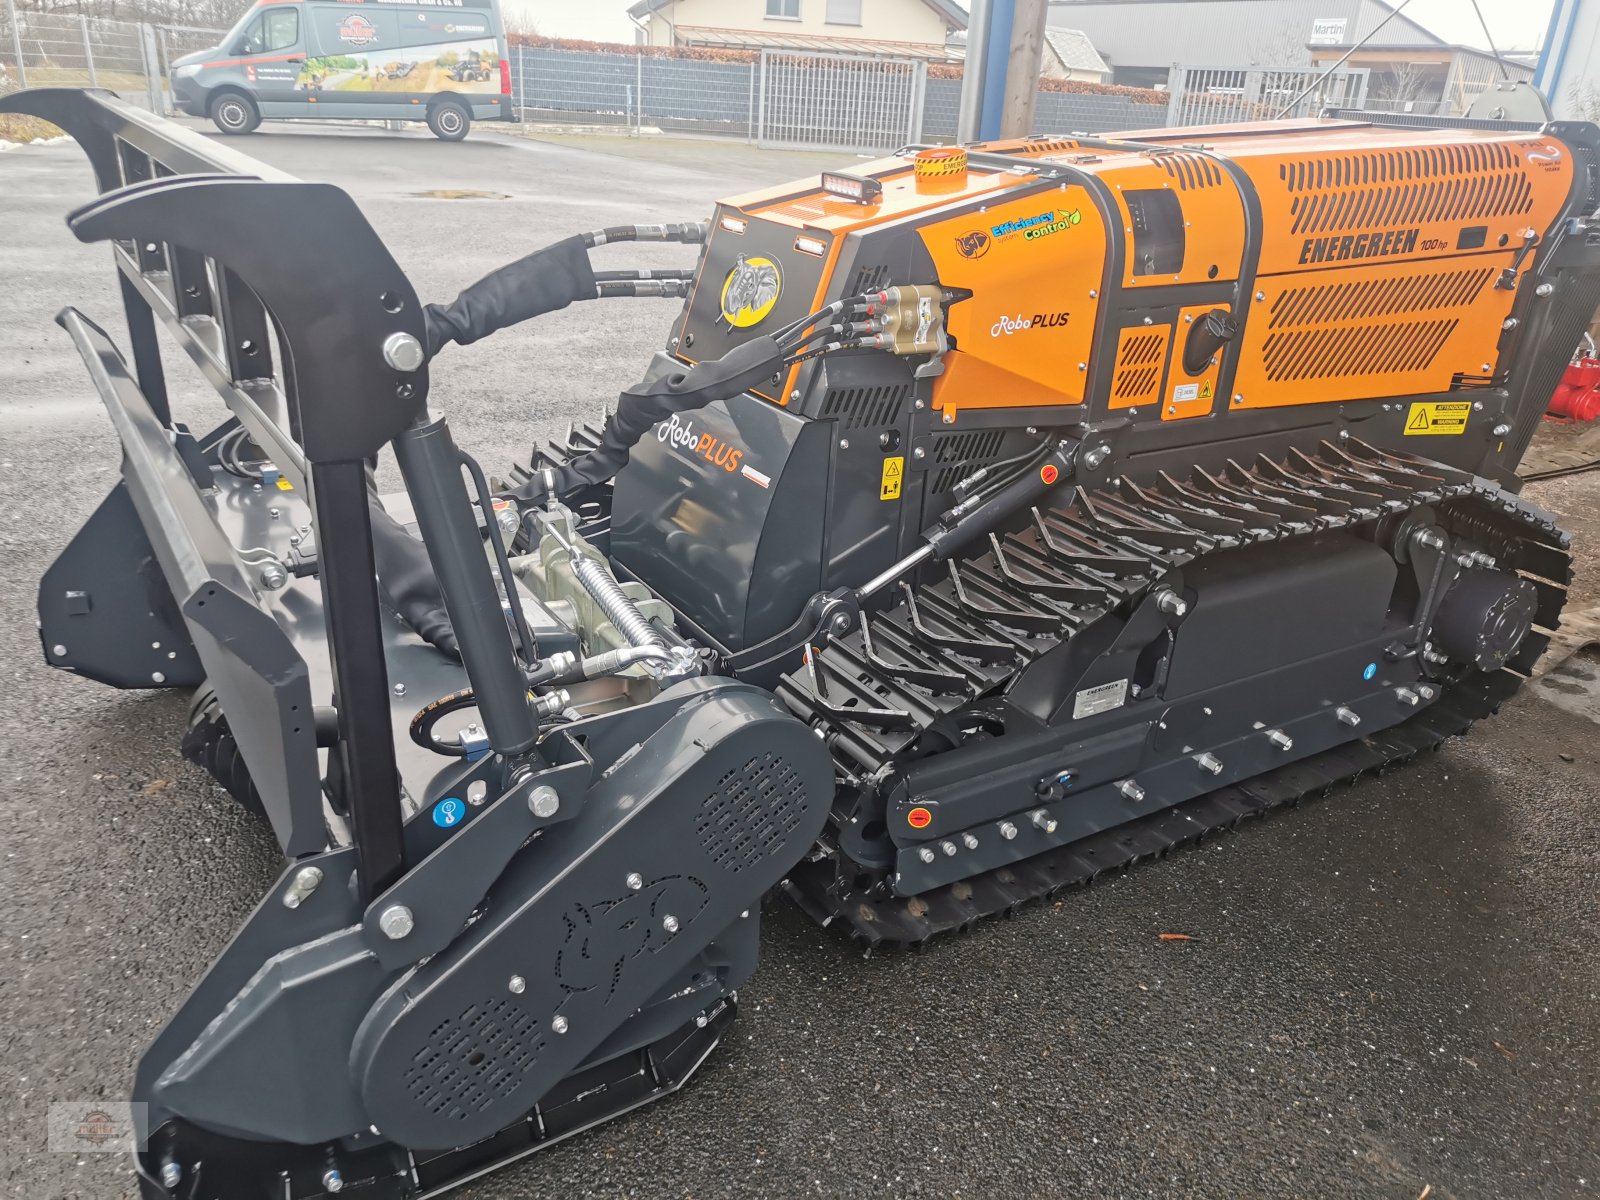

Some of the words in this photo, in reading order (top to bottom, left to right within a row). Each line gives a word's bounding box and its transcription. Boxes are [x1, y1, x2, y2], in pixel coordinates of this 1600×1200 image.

[991, 211, 1054, 237] Efficiency
[1023, 217, 1070, 241] Control
[1298, 229, 1419, 264] ENERGREEN
[990, 312, 1070, 337] RoboPLUS
[657, 413, 743, 472] RoboPLUS
[1086, 683, 1119, 695] ENERGREEN
